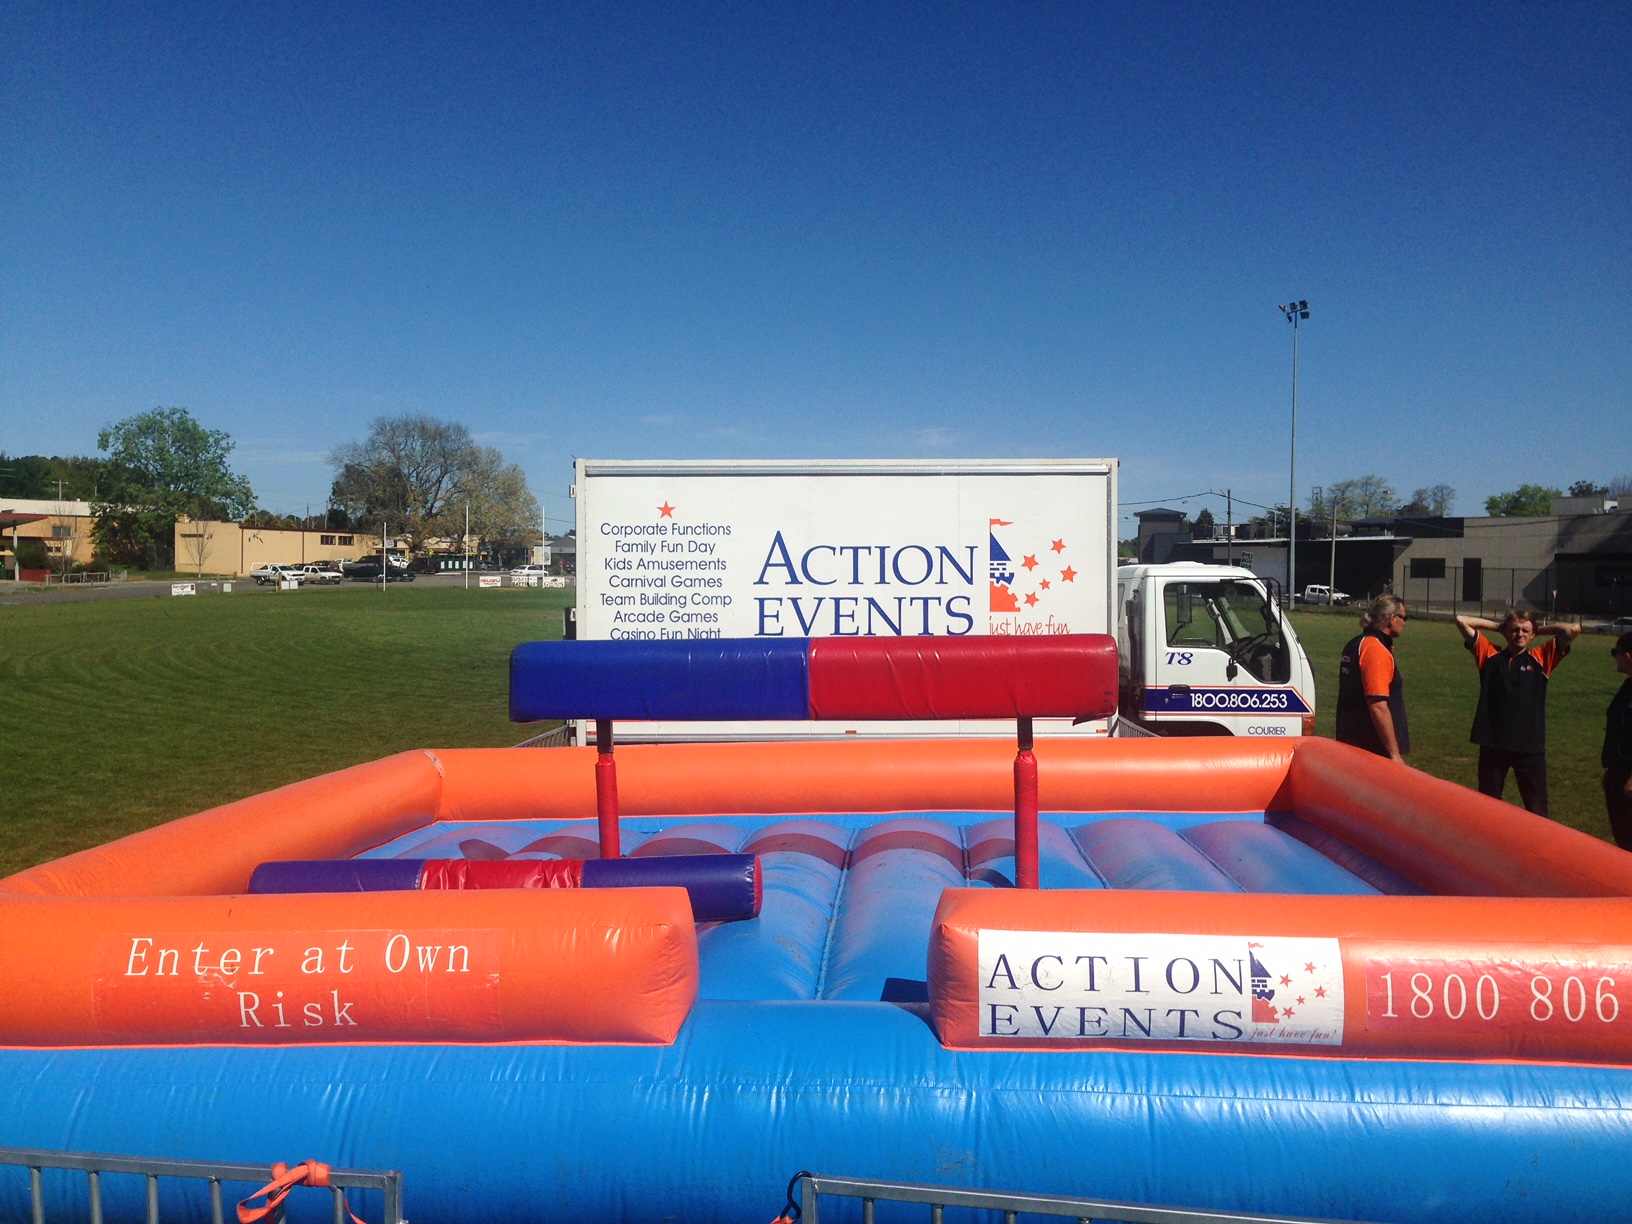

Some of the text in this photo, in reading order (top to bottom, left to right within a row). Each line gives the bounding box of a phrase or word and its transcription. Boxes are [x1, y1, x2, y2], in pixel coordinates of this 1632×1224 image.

[600, 523, 732, 538] Corporate Functions
[615, 540, 716, 555] Family Fun Day
[604, 557, 727, 570] Kids Amusements
[753, 530, 979, 586] ACTION
[608, 575, 723, 588] Carnival Games
[600, 593, 733, 608] Team Building Comp
[613, 610, 719, 623] Arcade Games
[753, 595, 975, 637] EVENTS
[1014, 616, 1043, 636] have
[610, 628, 721, 640] Casino Fun Night
[1165, 652, 1194, 665] T8
[1190, 693, 1288, 708] 1800.806.253
[1247, 726, 1287, 735] COURIER
[125, 934, 470, 977] Enter at Own
[985, 953, 1246, 996] ACTION
[1380, 972, 1620, 1023] 1800 806
[236, 989, 358, 1028] Risk
[985, 1003, 1244, 1041] EVENTS
[1250, 1027, 1276, 1041] just
[1279, 1027, 1306, 1038] have
